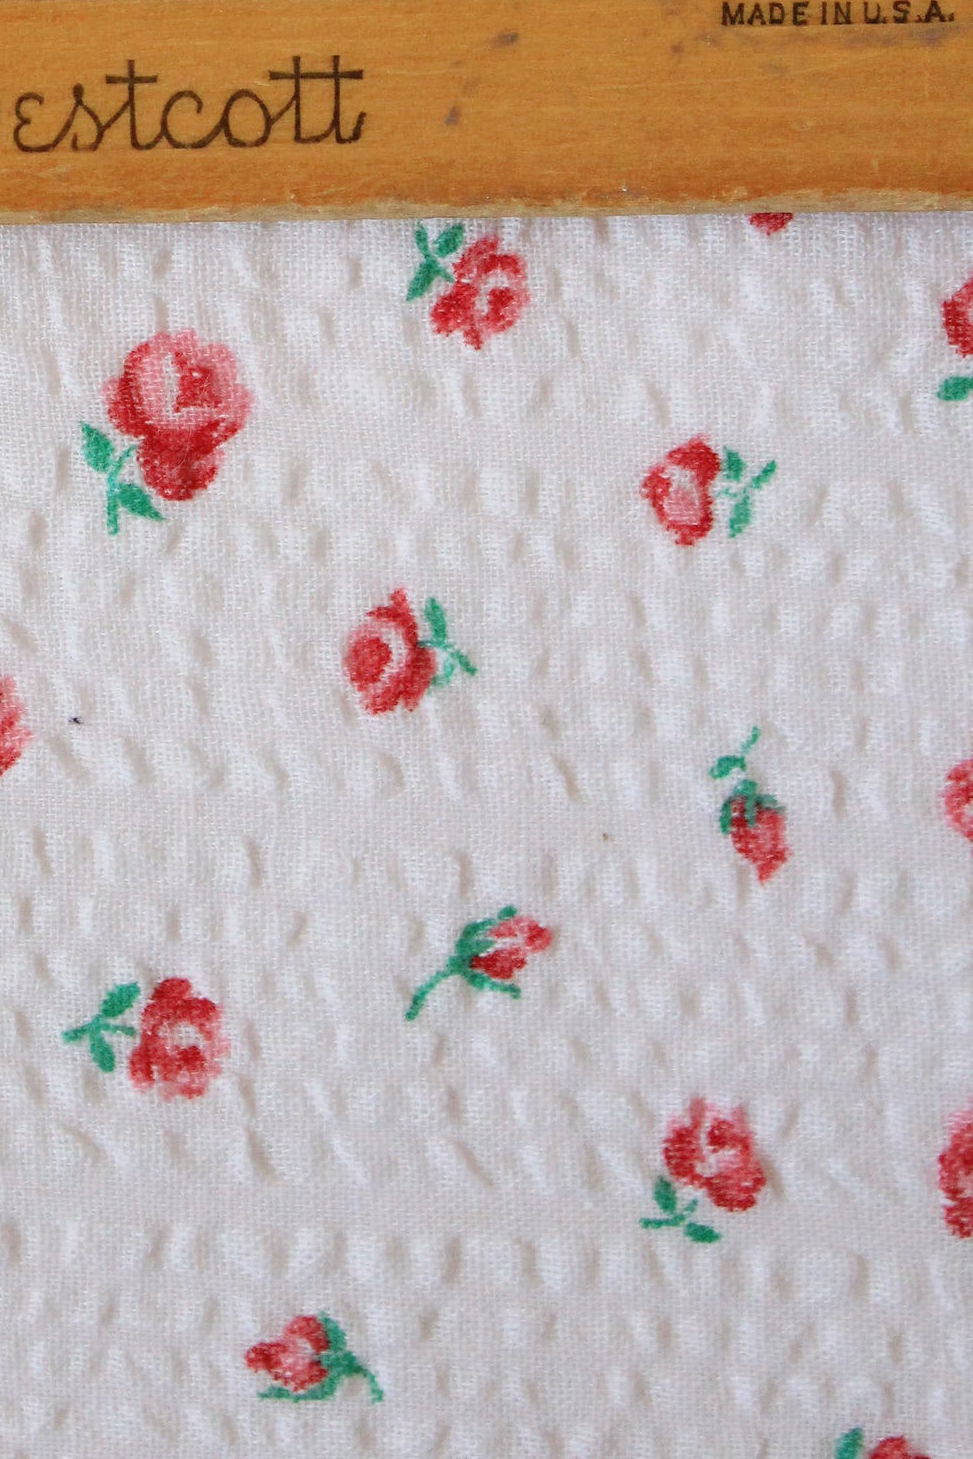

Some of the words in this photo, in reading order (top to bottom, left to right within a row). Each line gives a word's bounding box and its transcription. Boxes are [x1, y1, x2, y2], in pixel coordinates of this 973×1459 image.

[721, 1, 809, 27] MADE
[821, 1, 853, 26] IN
[863, 0, 955, 25] U.S.A.
